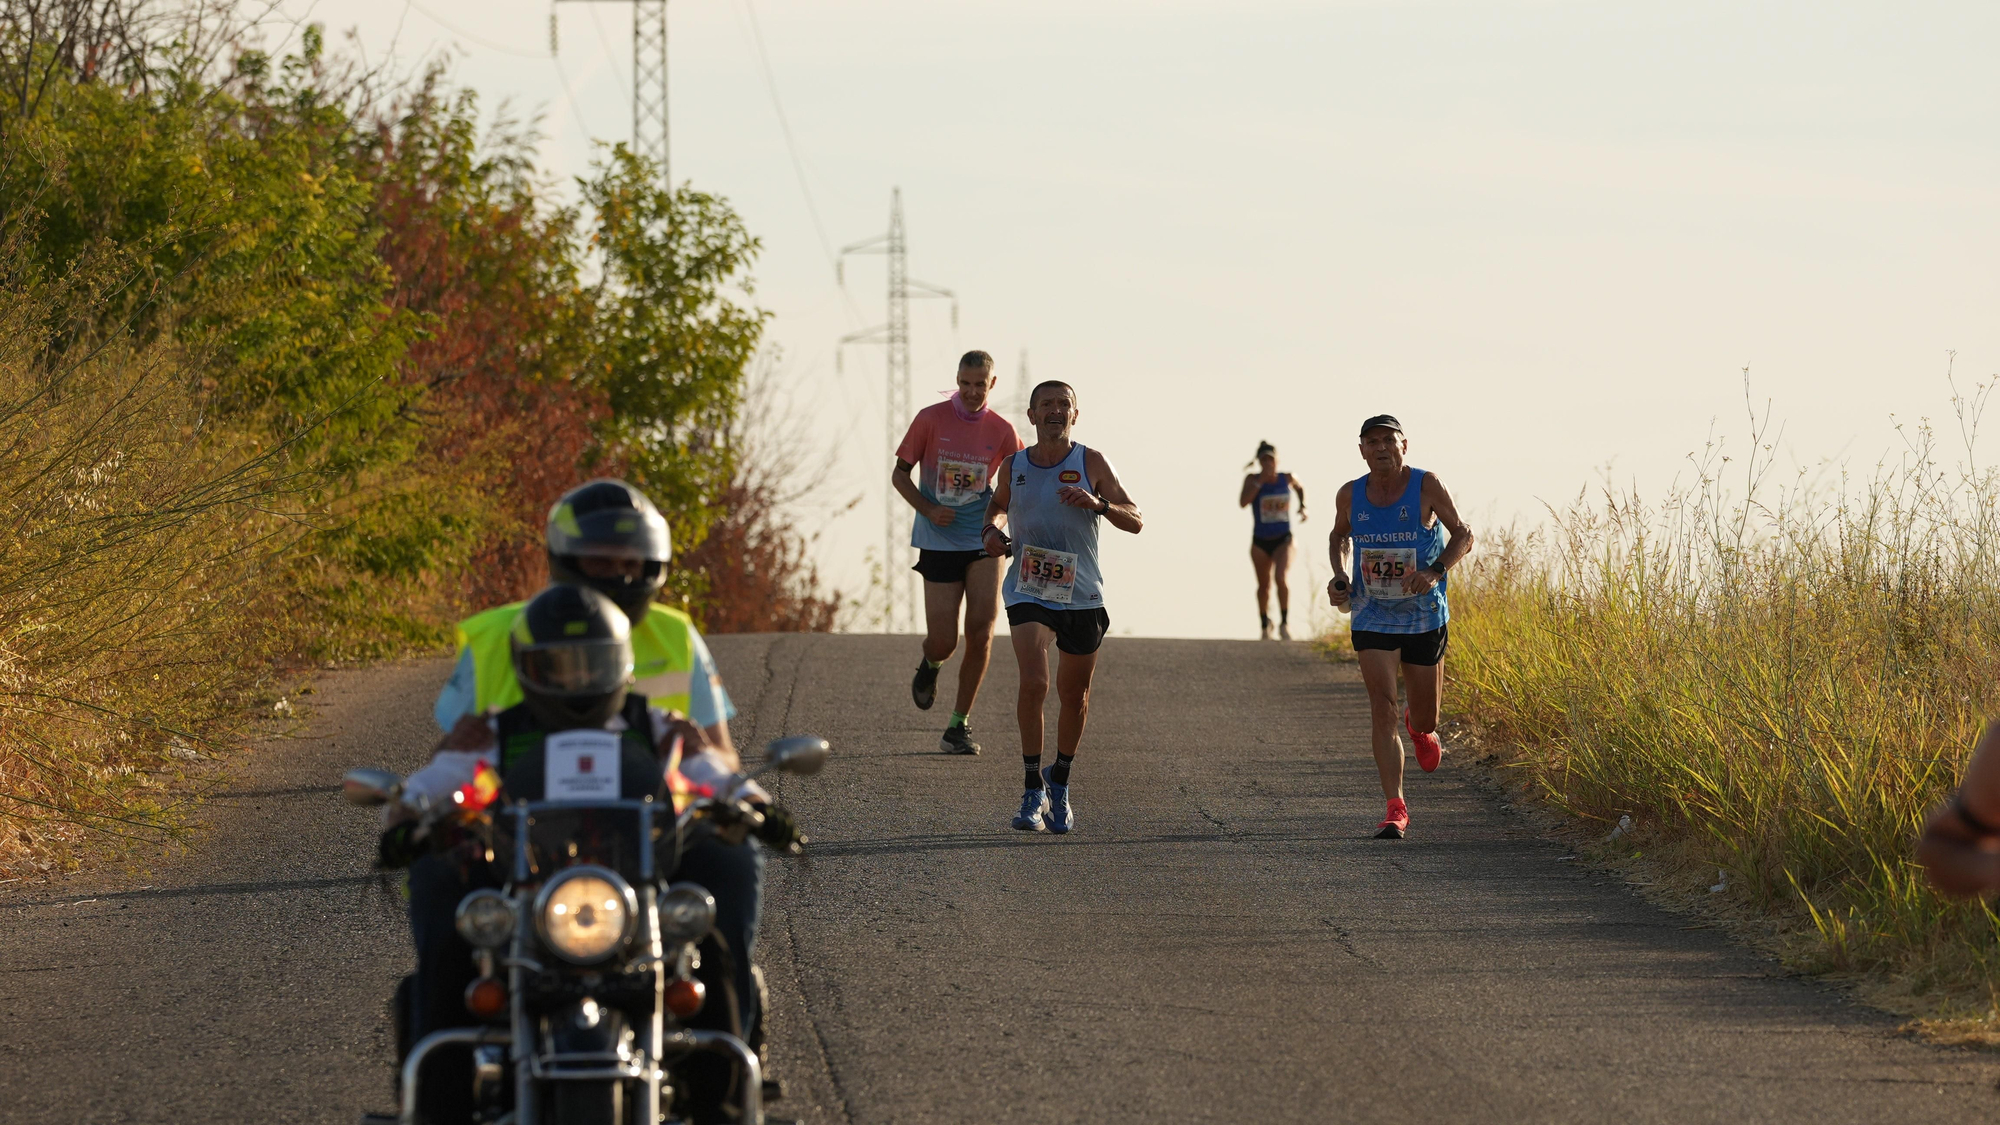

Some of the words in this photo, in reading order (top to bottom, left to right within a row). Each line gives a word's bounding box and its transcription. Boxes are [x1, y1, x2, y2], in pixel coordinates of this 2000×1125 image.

[937, 448, 961, 459] Medio
[953, 473, 971, 488] 55
[1354, 531, 1418, 543] TROTASIERRA
[1031, 559, 1064, 580] 353
[1372, 561, 1405, 577] 425
